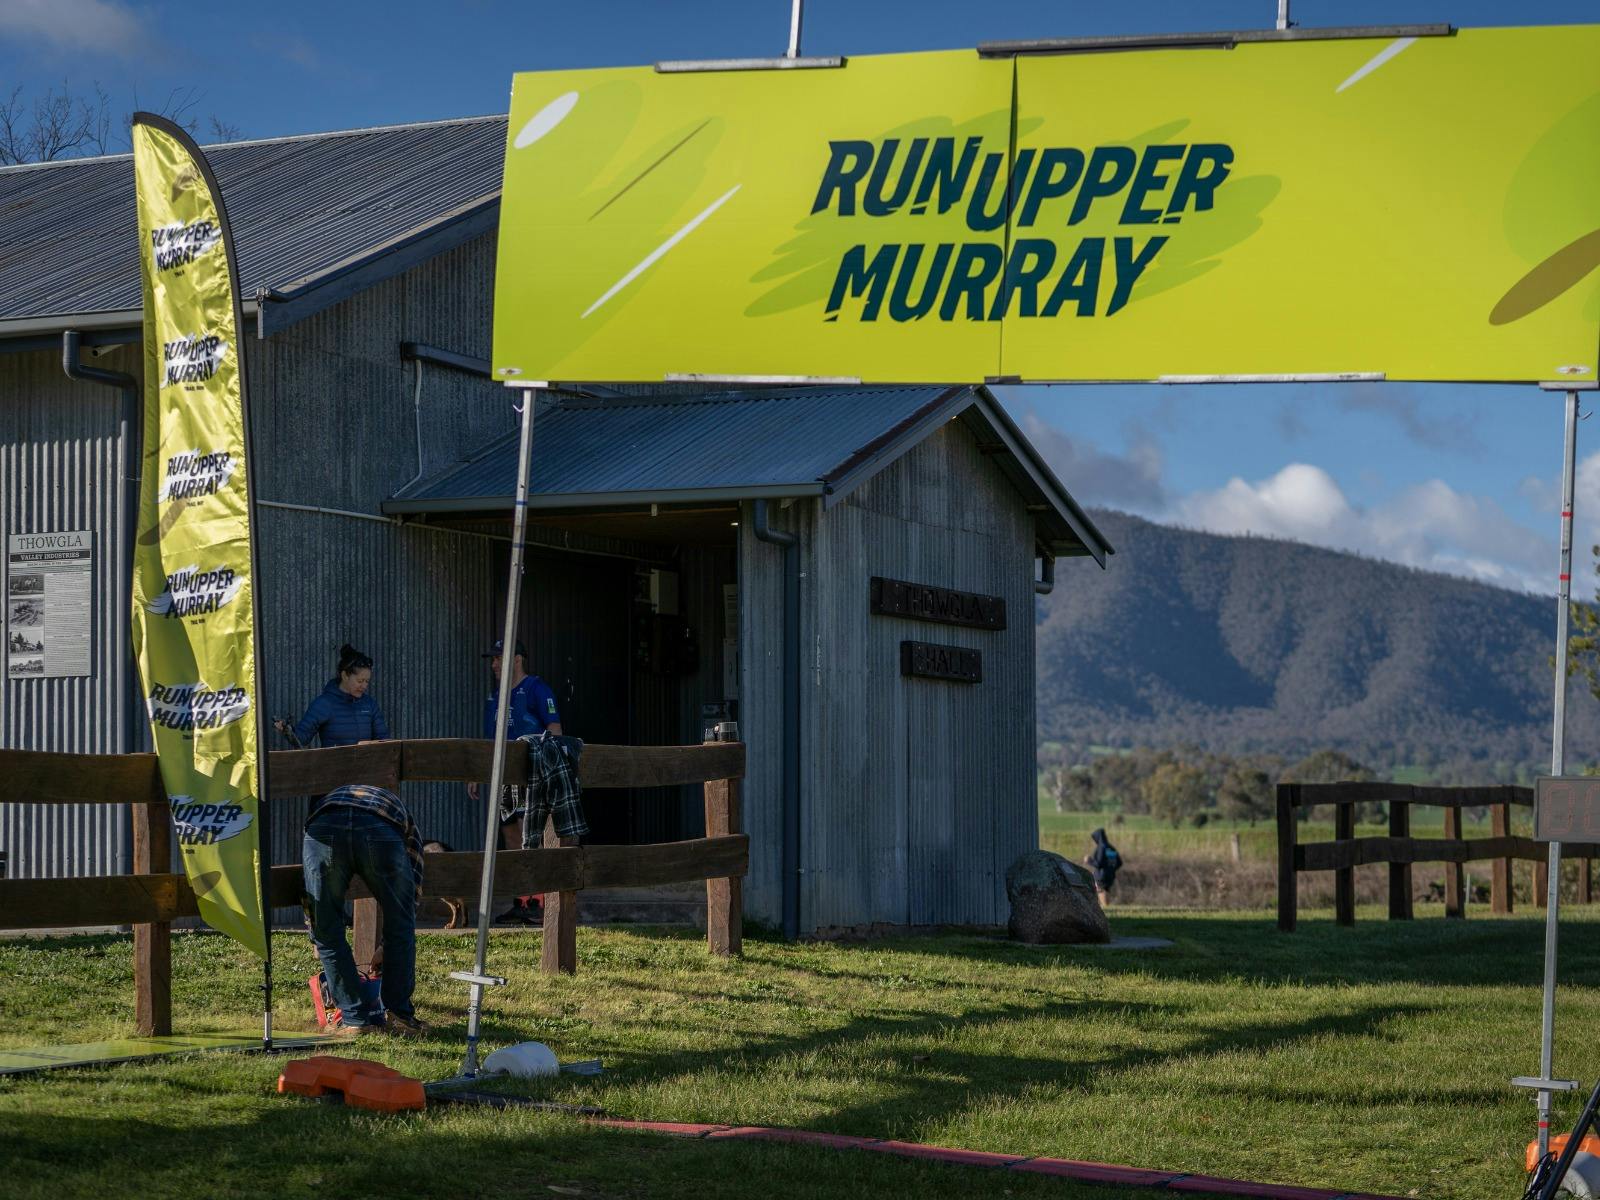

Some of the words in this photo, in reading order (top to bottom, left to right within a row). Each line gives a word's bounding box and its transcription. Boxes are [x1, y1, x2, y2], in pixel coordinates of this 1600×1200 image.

[823, 235, 1170, 323] MURRAY
[167, 358, 214, 387] MURRAY
[167, 474, 223, 502] MURRAY
[18, 535, 83, 550] THOWGLA
[44, 552, 80, 560] INDUSTRIES
[164, 592, 225, 619] MURRAY
[903, 583, 985, 622] THOWGLA
[152, 708, 232, 731] MURRAY
